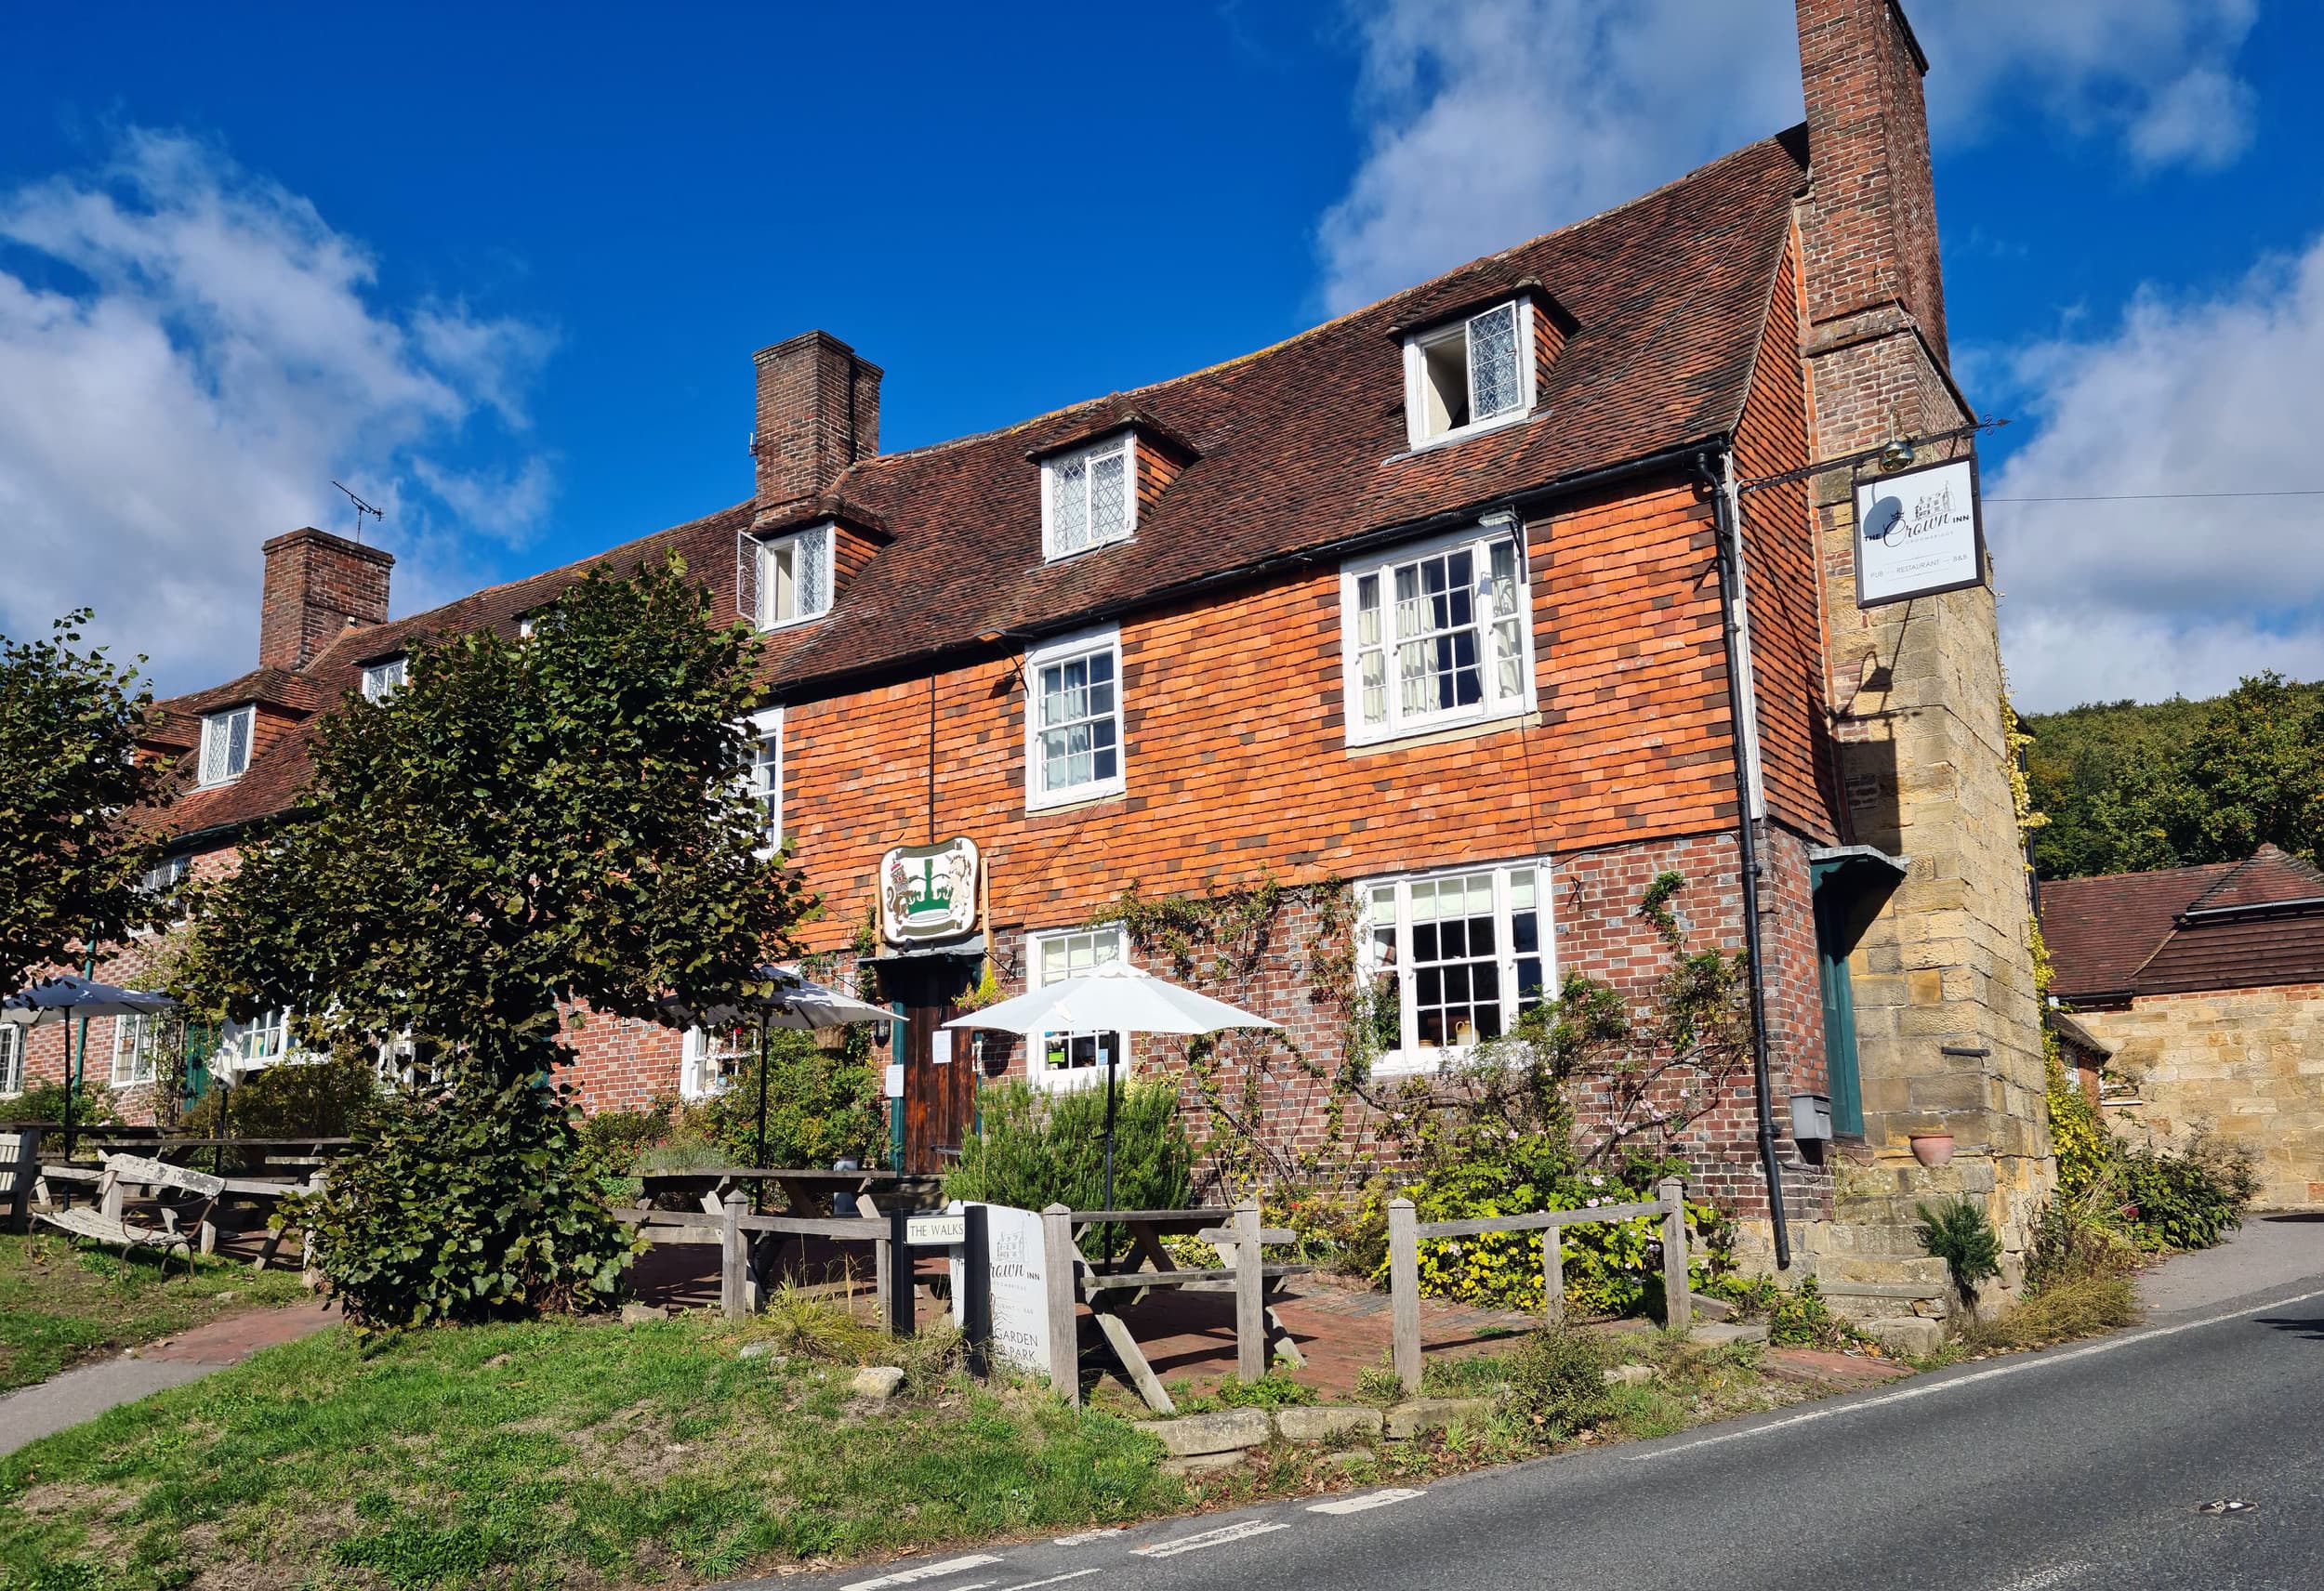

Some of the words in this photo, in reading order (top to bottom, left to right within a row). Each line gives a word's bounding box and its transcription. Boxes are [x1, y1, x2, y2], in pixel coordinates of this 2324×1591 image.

[1863, 533, 1882, 542] THE
[1883, 513, 1949, 547] Crown
[1953, 514, 1970, 523] INN
[1870, 571, 1883, 579] PUB
[1896, 559, 1940, 573] RESTAURANT
[909, 1225, 927, 1237] THE
[931, 1223, 964, 1235] WALKS
[989, 1263, 1025, 1279] rown
[1027, 1271, 1040, 1281] INN
[994, 1328, 1038, 1347] GARDEN
[1010, 1347, 1037, 1362] PARK
